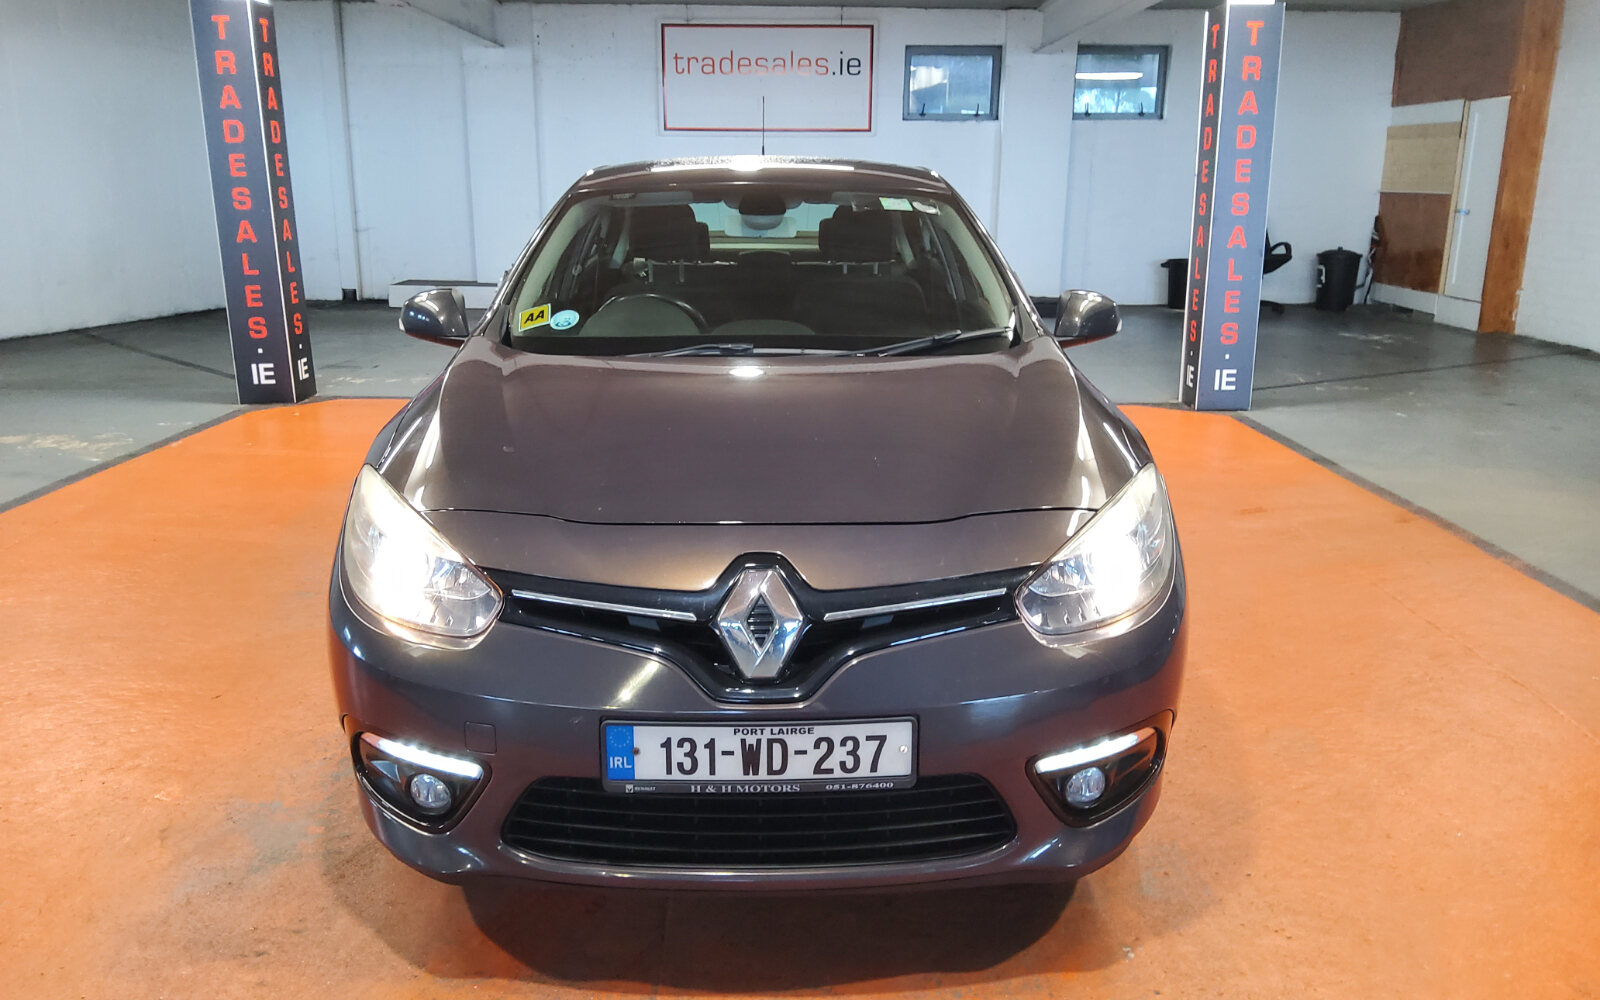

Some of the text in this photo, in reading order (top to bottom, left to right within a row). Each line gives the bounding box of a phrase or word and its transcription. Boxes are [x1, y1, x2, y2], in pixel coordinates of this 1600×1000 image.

[673, 49, 862, 76] tradesales.ie
[524, 309, 545, 325] AA
[733, 726, 815, 736] PORT LAIRGE
[609, 756, 632, 769] IRL
[660, 734, 888, 777] 131-WD-237
[690, 783, 801, 793] H & H MOTORS
